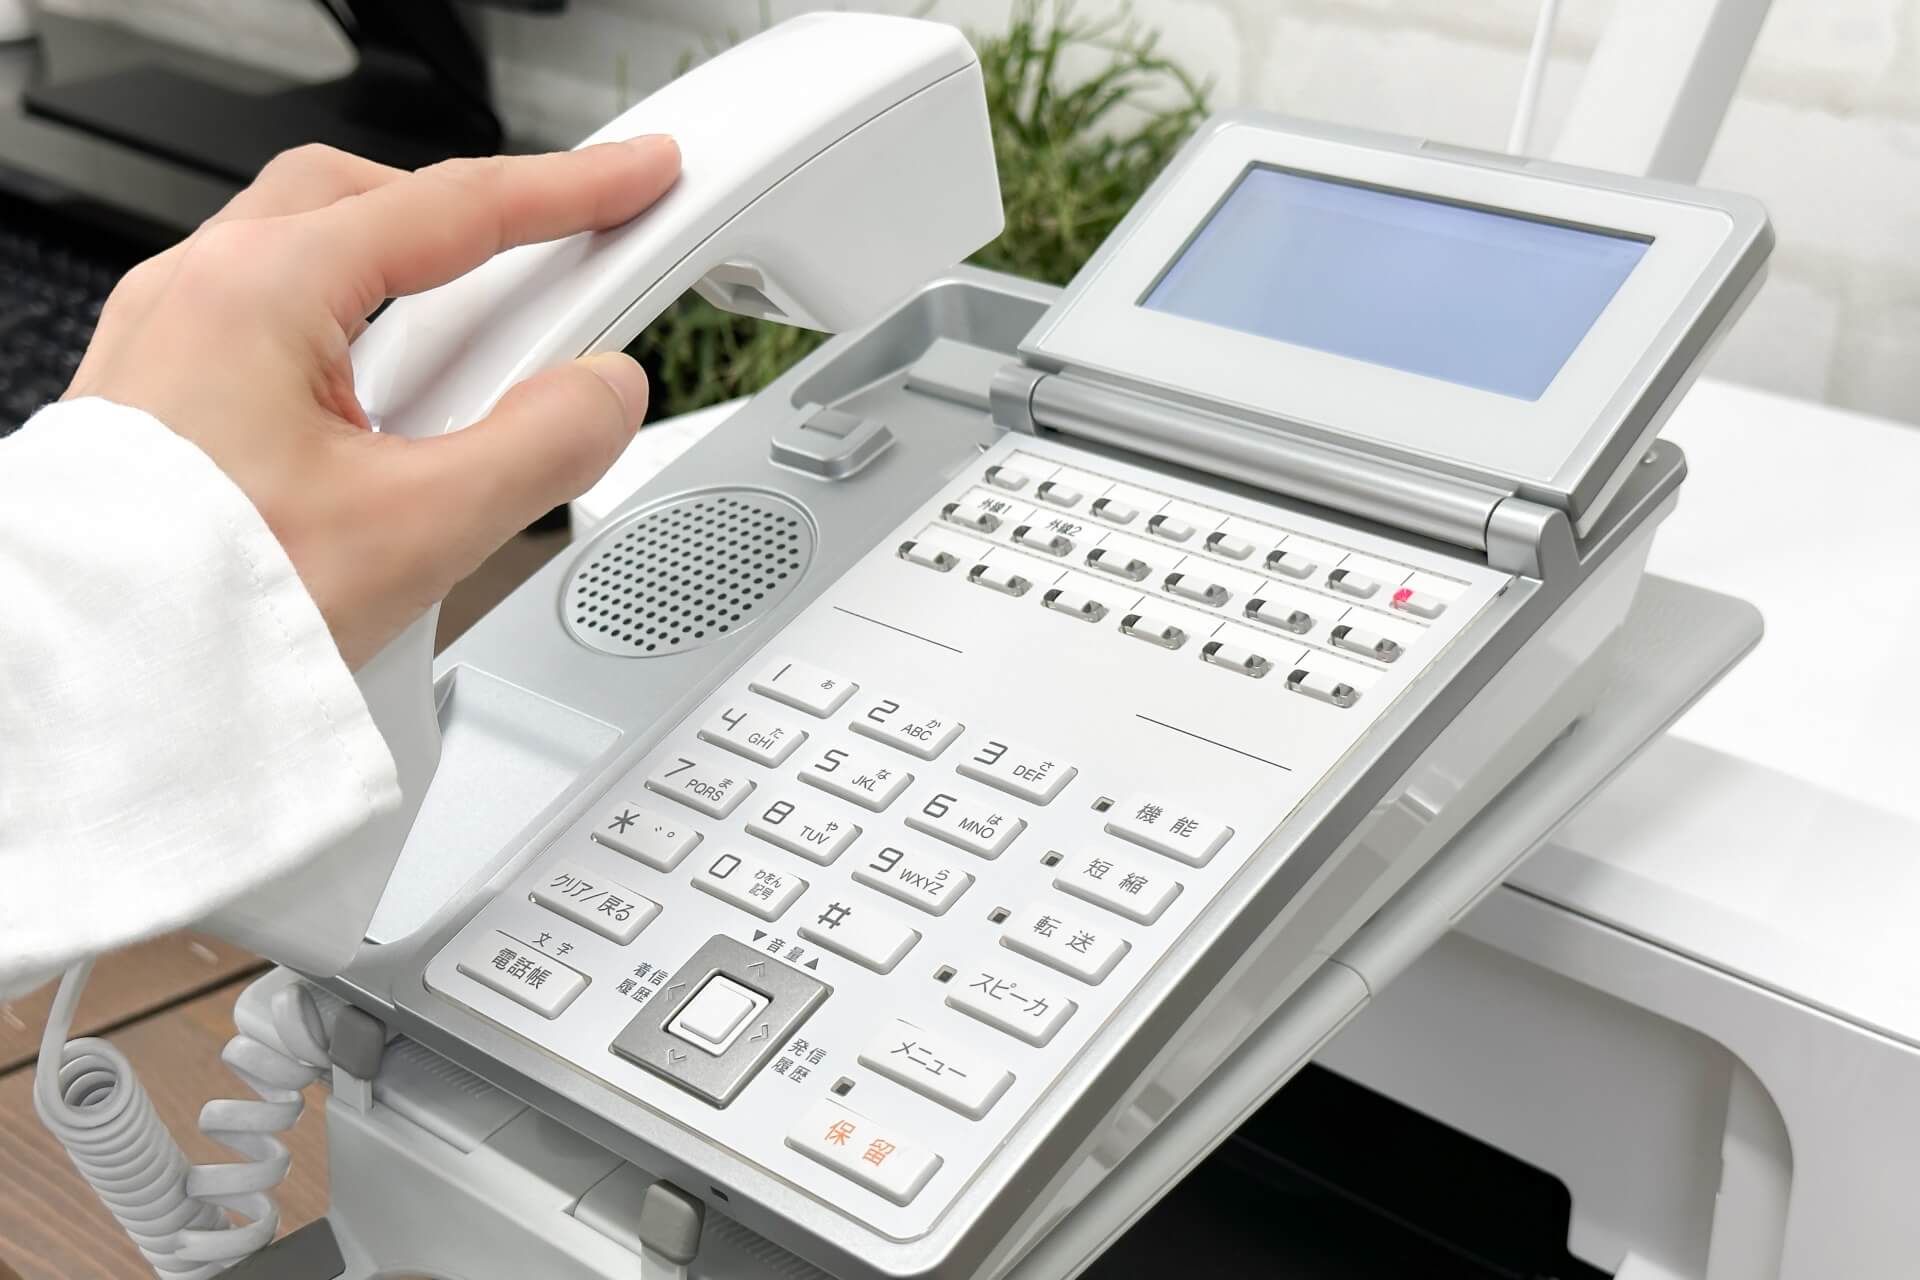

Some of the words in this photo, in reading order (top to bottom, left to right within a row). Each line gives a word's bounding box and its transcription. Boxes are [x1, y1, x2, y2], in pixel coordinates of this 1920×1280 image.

[821, 680, 835, 689] あ
[722, 708, 747, 731] 4
[747, 731, 775, 751] GHI
[769, 728, 784, 739] た
[868, 700, 899, 723] 2
[900, 723, 933, 742] ABC
[927, 720, 941, 728] か
[664, 758, 696, 777] 7
[815, 749, 848, 772] 5
[852, 774, 877, 791] JKL
[877, 769, 891, 780] な
[974, 741, 1008, 765] 3
[1013, 763, 1047, 782] DEF
[1040, 762, 1054, 772] さ
[719, 779, 733, 789] ま
[763, 801, 795, 824] 8
[800, 824, 829, 844] TUV
[826, 822, 838, 831] や
[923, 794, 957, 818] 6
[958, 818, 995, 840] MNO
[987, 815, 1003, 825] は
[1134, 804, 1198, 837] 機能
[709, 854, 741, 879] 0
[753, 870, 781, 889] わをん
[869, 848, 904, 874] 9
[901, 869, 944, 895] WXYZ
[935, 870, 949, 880] ら
[1083, 858, 1148, 896] 短縮
[550, 874, 636, 923] クリア/戻る
[749, 882, 774, 900] 記号
[532, 933, 573, 955] 文字
[1032, 916, 1095, 954] 転送
[766, 937, 805, 962] 音量
[490, 948, 552, 989] 電話帳
[633, 963, 669, 986] 着信
[616, 978, 652, 1004] 履歴
[968, 973, 1048, 1018] スピーカ
[789, 1038, 826, 1065] 発信
[891, 1040, 966, 1078] メニュー
[771, 1056, 808, 1083] 履歴
[825, 1120, 896, 1166] 保留
